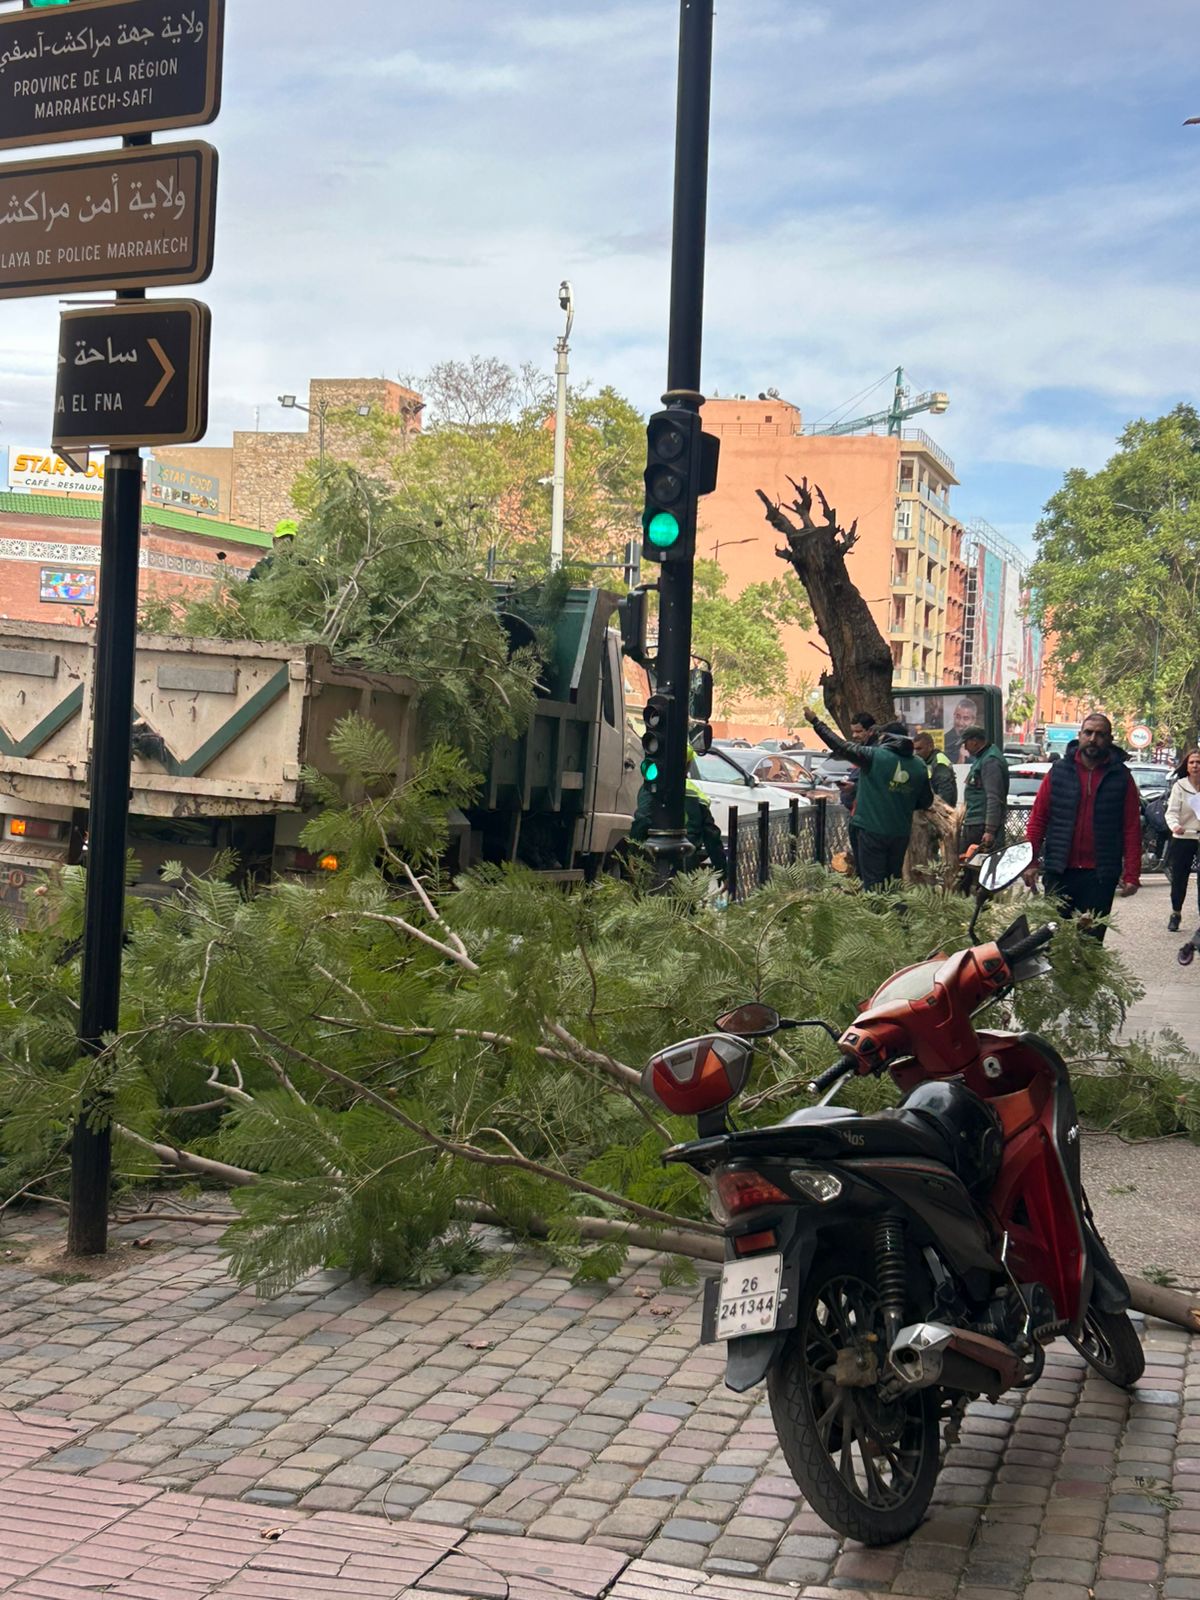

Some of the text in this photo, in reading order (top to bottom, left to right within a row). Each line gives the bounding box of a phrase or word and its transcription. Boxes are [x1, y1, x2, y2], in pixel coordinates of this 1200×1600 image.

[117, 24, 154, 46] جهة
[162, 10, 204, 43] ولاية
[13, 57, 179, 97] PROVINCE DE LA RÉGION
[34, 88, 153, 119] MARRAKECH-SAFI
[78, 173, 119, 223] أمن
[128, 175, 186, 220] ولاية
[36, 249, 51, 265] DE
[58, 244, 101, 263] POLICE
[107, 236, 188, 259] MARRAKECH
[74, 336, 138, 366] ساحة
[72, 393, 87, 412] EL
[95, 392, 123, 411] FNA
[13, 454, 67, 477] STAR
[162, 468, 186, 484] STAR
[25, 478, 49, 487] CAFÉ
[741, 1276, 759, 1294] 26
[720, 1296, 774, 1320] 241344
